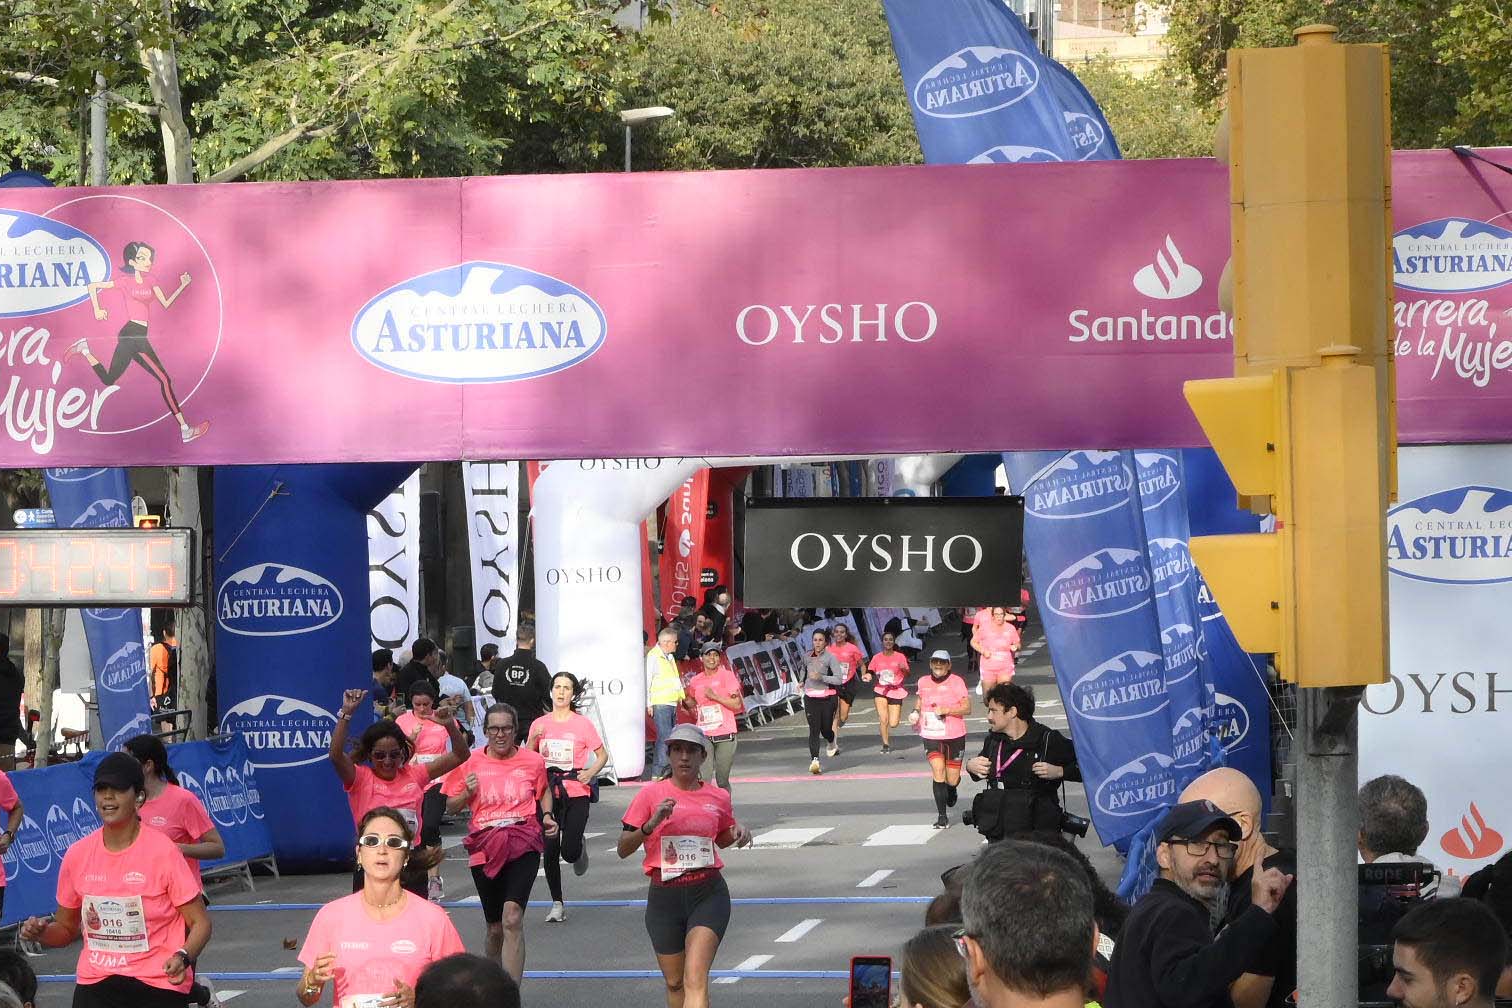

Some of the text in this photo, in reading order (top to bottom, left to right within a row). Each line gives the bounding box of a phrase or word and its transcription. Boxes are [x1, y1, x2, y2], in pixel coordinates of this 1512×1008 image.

[13, 245, 86, 257] LECHERA
[1464, 242, 1512, 251] LECHER
[409, 301, 578, 318] CENTRAL LECHERA
[1394, 298, 1489, 328] arrera
[371, 308, 586, 353] ASTURIANA
[735, 301, 938, 346] OYSHO
[1417, 328, 1435, 356] la
[1431, 322, 1512, 388] Muje
[1415, 520, 1482, 531] CENTRAL
[790, 533, 983, 574] OYSHO
[1388, 523, 1512, 561] ASTURI
[546, 566, 622, 585] OYSHO
[234, 588, 329, 597] CENTRAL LECHERA
[221, 593, 334, 619] ASTURIANA
[1361, 671, 1512, 716] OYSH
[226, 723, 331, 749] TURIANA
[235, 720, 330, 729] CENTRAL LECHERA
[102, 918, 123, 928] 016
